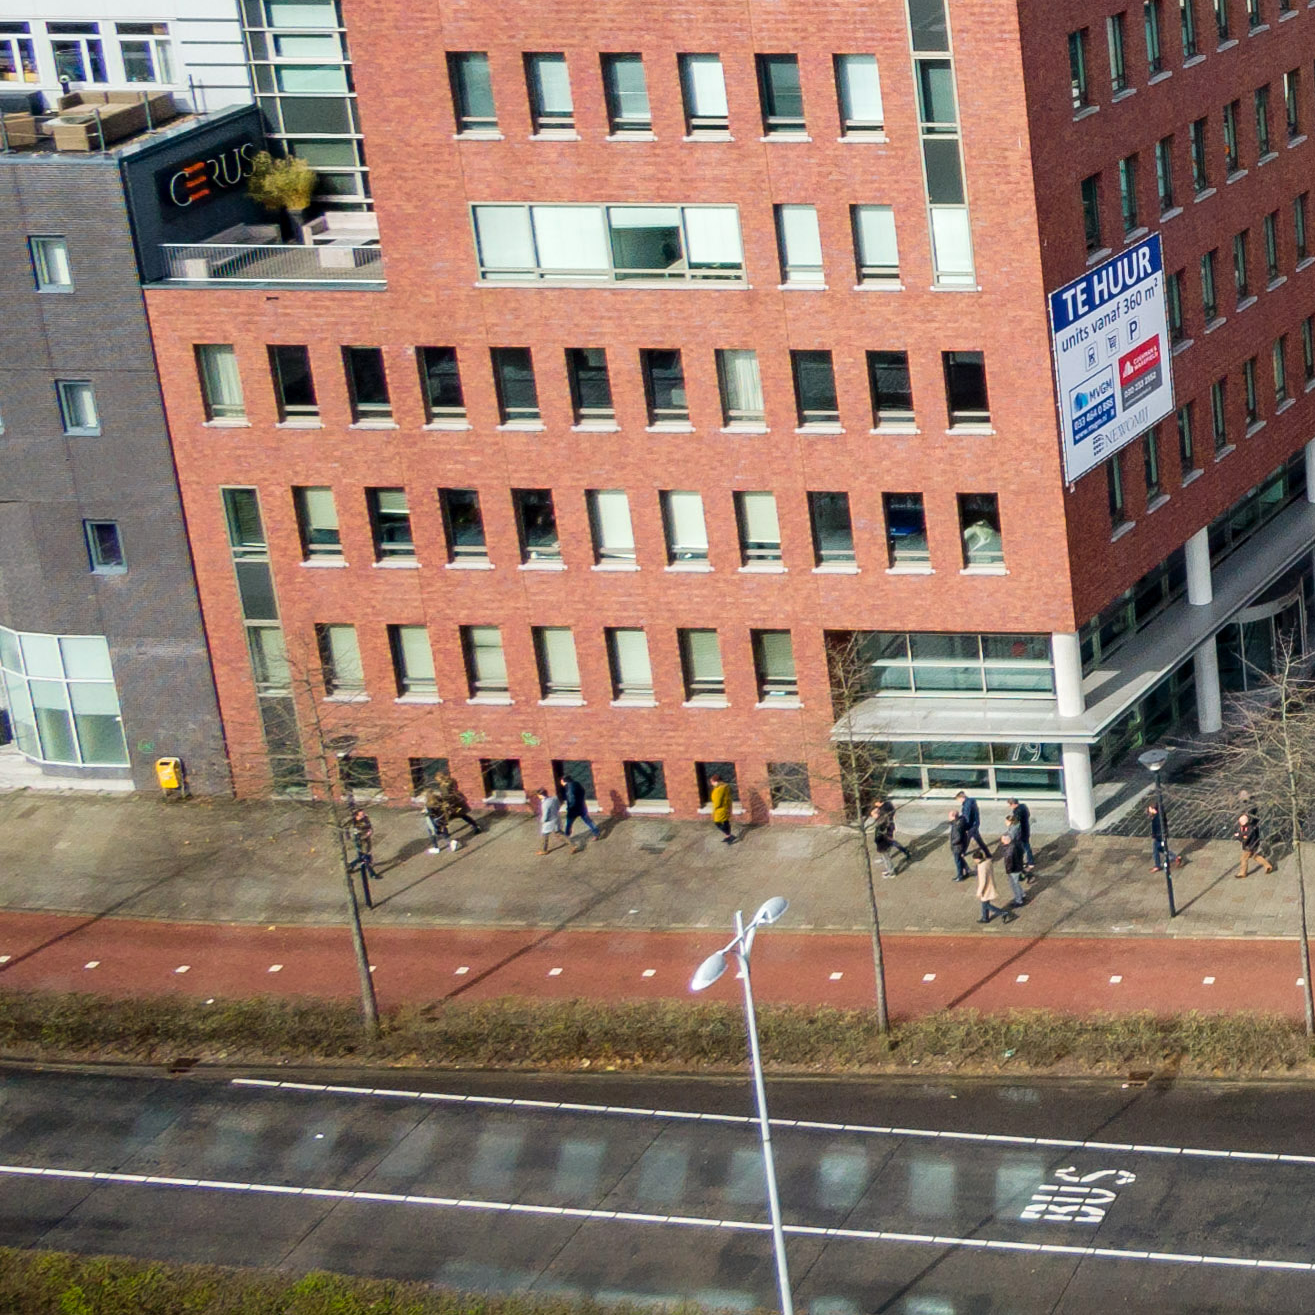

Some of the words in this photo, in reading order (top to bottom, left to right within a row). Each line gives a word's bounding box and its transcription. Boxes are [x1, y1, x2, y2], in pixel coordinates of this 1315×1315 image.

[170, 143, 256, 206] CERUS
[1062, 281, 1089, 322] TE
[1093, 246, 1152, 305] HUUR
[1062, 326, 1089, 353] units
[1092, 302, 1120, 334] vanaf
[1123, 290, 1142, 314] 360
[1089, 378, 1113, 401] MVGM
[1105, 407, 1149, 447] NEWOMIJ
[1020, 1166, 1137, 1224] BUS
